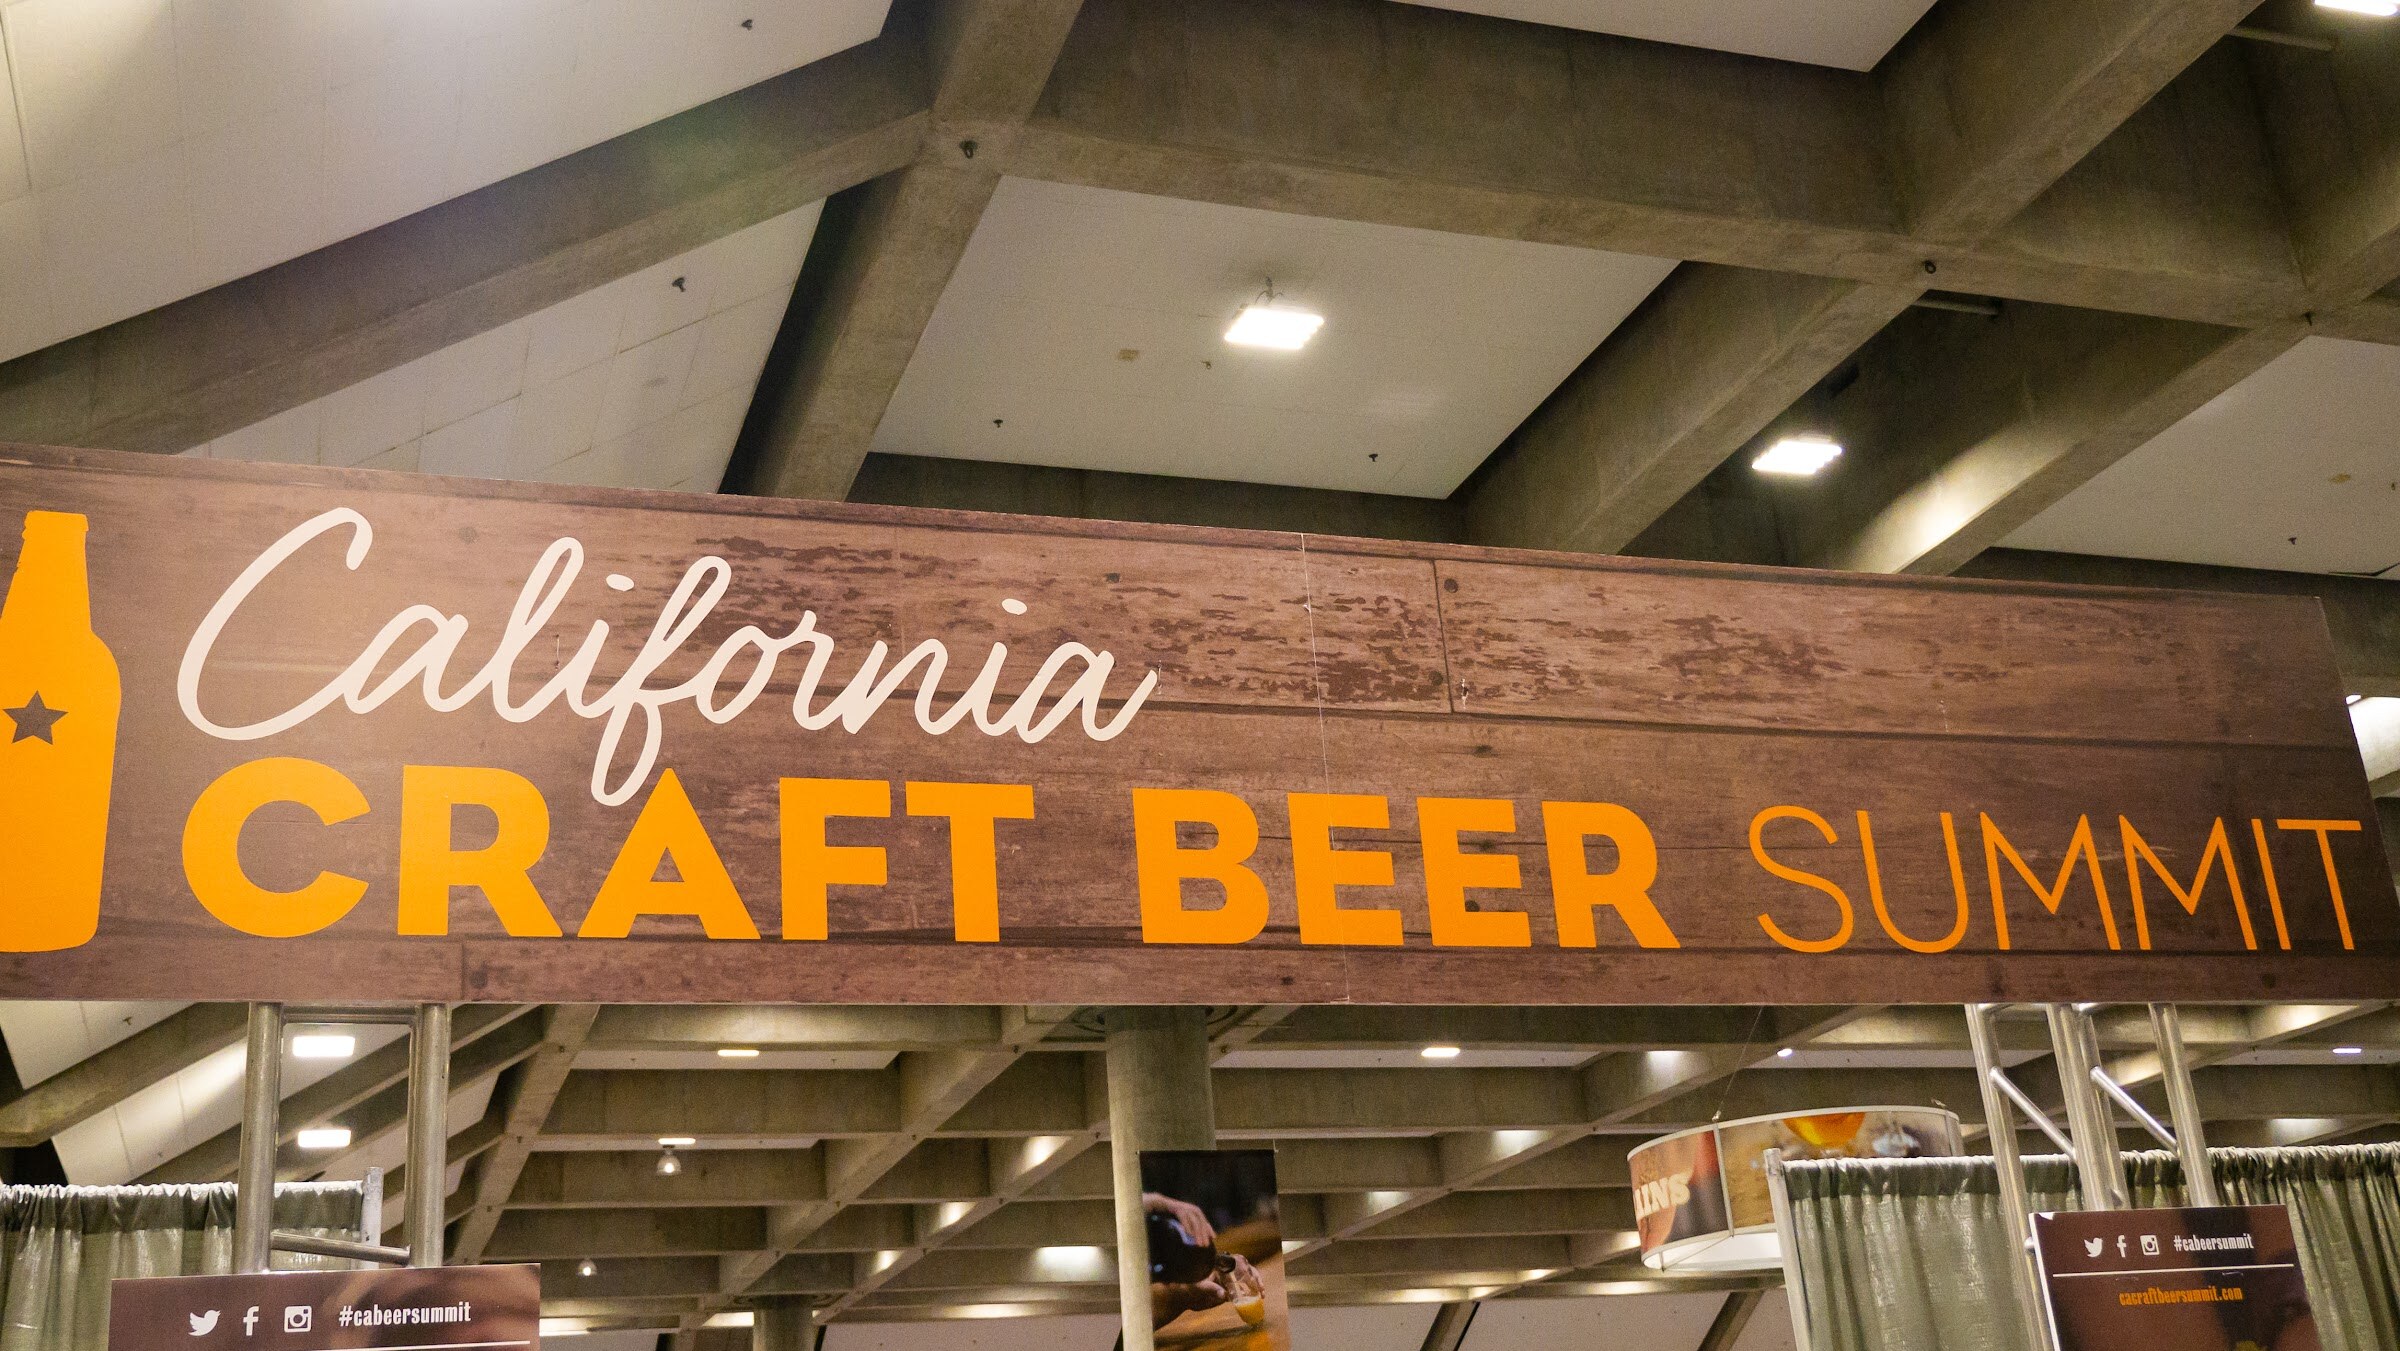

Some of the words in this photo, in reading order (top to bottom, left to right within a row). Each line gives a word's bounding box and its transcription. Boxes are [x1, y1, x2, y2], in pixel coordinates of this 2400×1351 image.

[177, 504, 1159, 808] California
[180, 757, 1036, 943] CRAFT
[1130, 785, 1683, 950] BEER
[1747, 803, 2363, 955] SUMMIT
[2173, 1233, 2254, 1252] #cabeersummit
[2118, 1286, 2243, 1306] cacraftbeersummit.com
[338, 1301, 472, 1327] #cabeersummit
